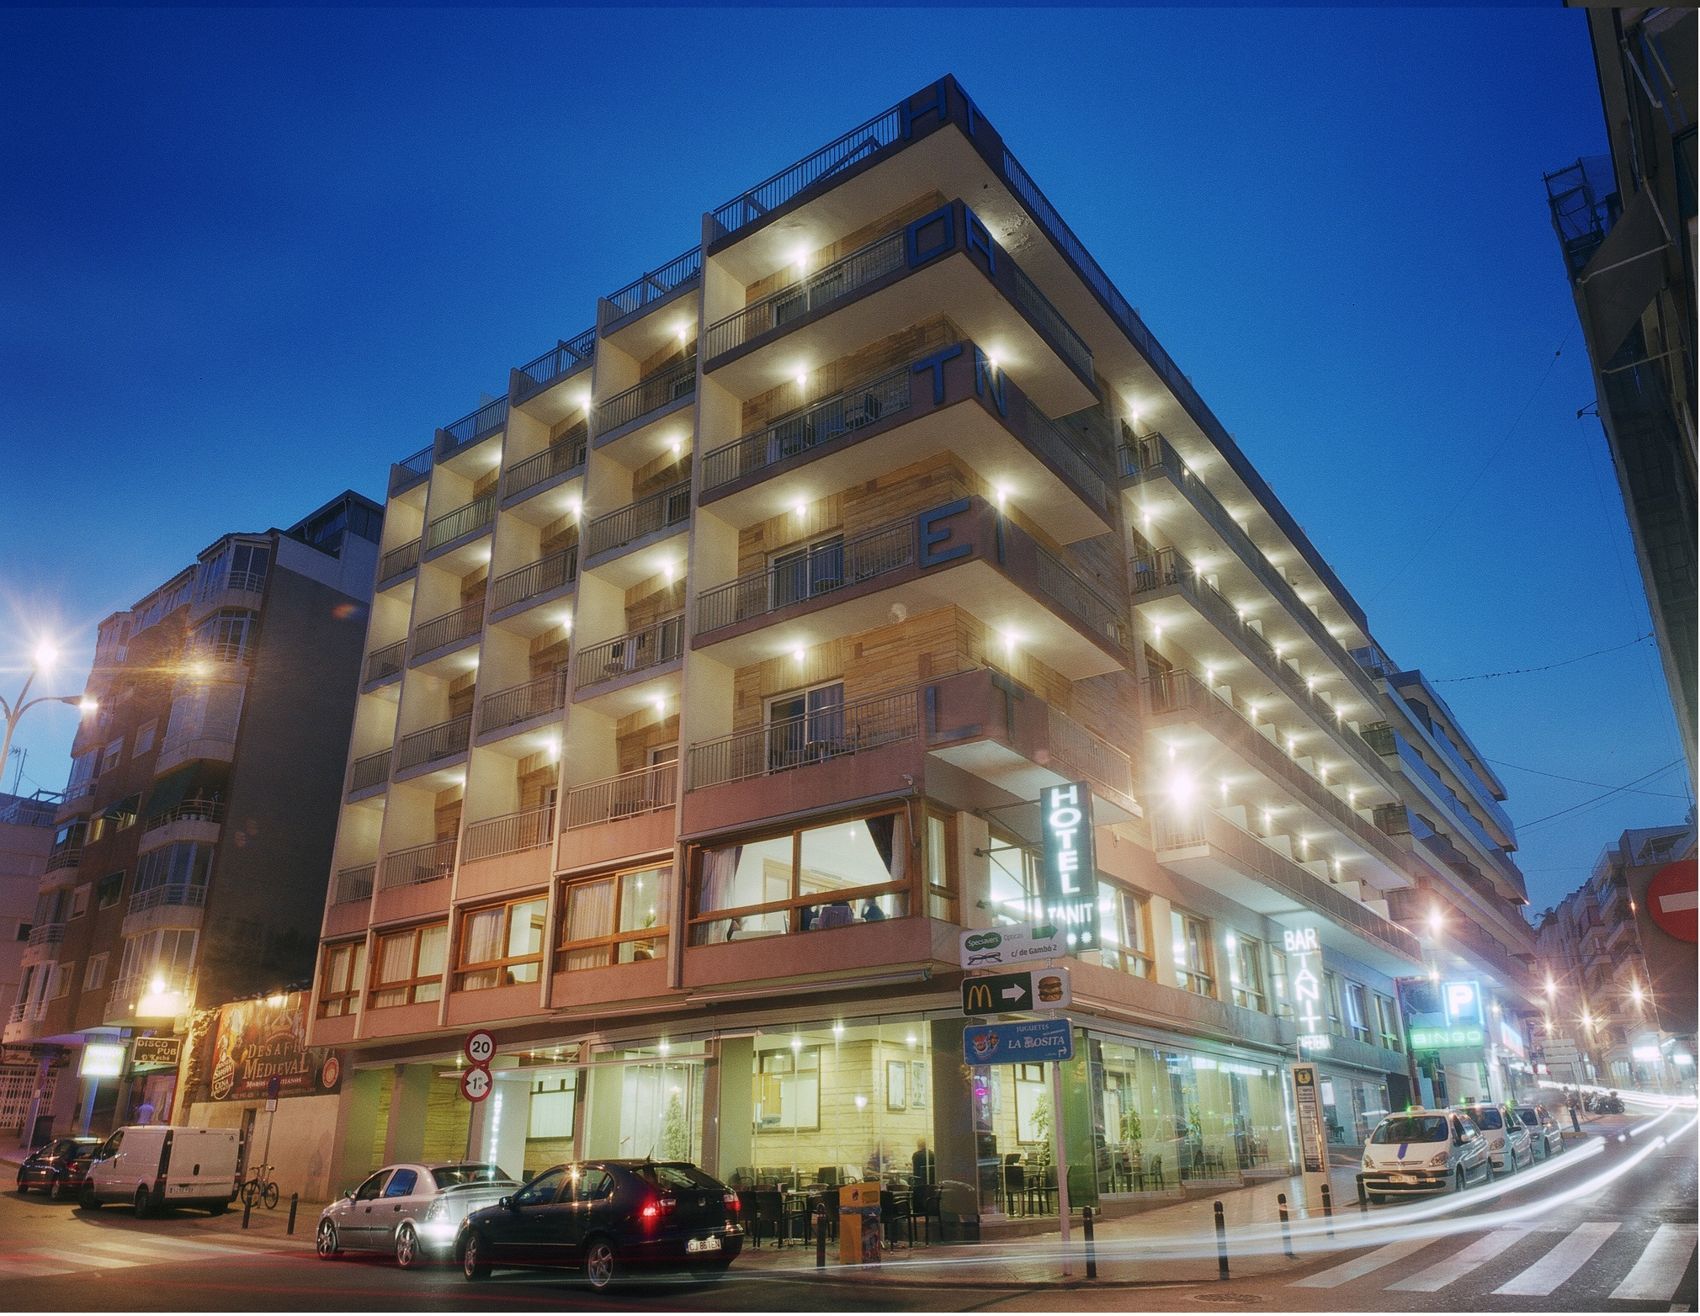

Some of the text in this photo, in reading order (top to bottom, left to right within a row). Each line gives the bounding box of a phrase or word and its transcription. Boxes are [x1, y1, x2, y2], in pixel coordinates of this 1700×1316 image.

[1050, 785, 1082, 895] HOTEL
[1047, 902, 1093, 925] TANIT
[1284, 928, 1318, 952] BAR
[1019, 948, 1028, 956] de
[1293, 952, 1322, 1034] TANIT
[1448, 985, 1473, 1017] P
[1016, 1023, 1050, 1033] JUGUETES
[137, 1039, 168, 1048] DISCO
[1008, 1040, 1022, 1049] LA
[1414, 1031, 1481, 1046] BINGO
[157, 1047, 177, 1056] PUB
[472, 1040, 490, 1053] 20
[242, 1052, 309, 1080] MEDIEVAL
